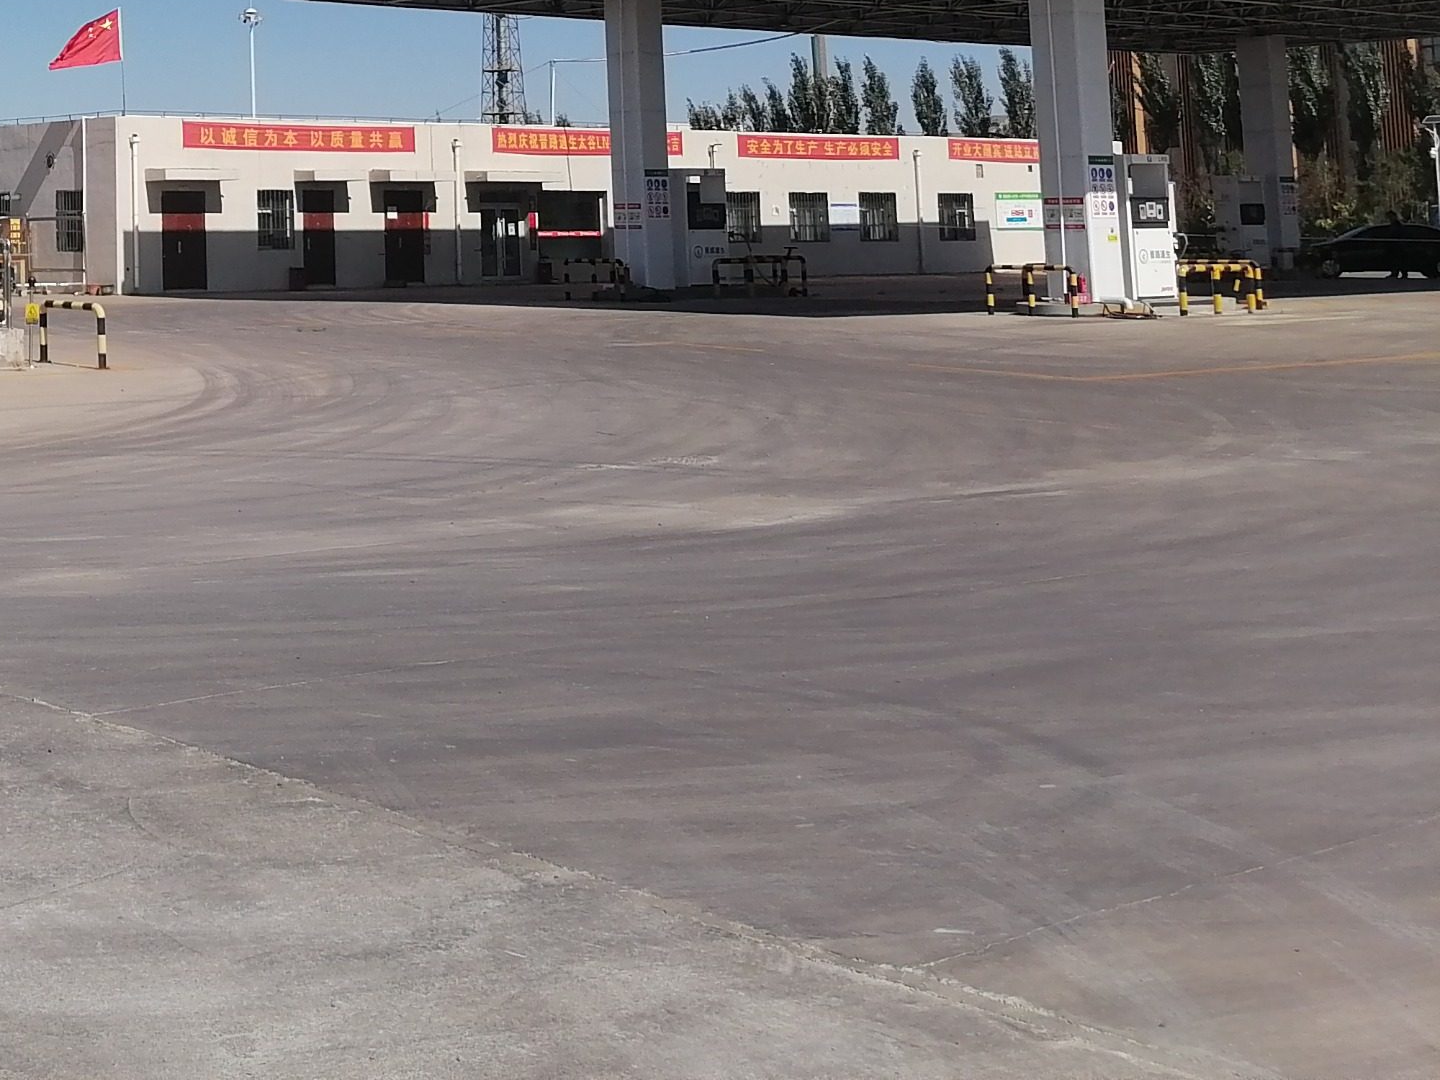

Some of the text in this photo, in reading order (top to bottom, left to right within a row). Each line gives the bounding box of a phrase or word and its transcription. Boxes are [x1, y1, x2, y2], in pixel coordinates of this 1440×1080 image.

[199, 126, 403, 149] 以诚信为本 以质量共赢
[497, 132, 611, 151] 热烈庆祝晋路道生太谷LN
[746, 139, 893, 157] 安全为了生产 生产必须安全
